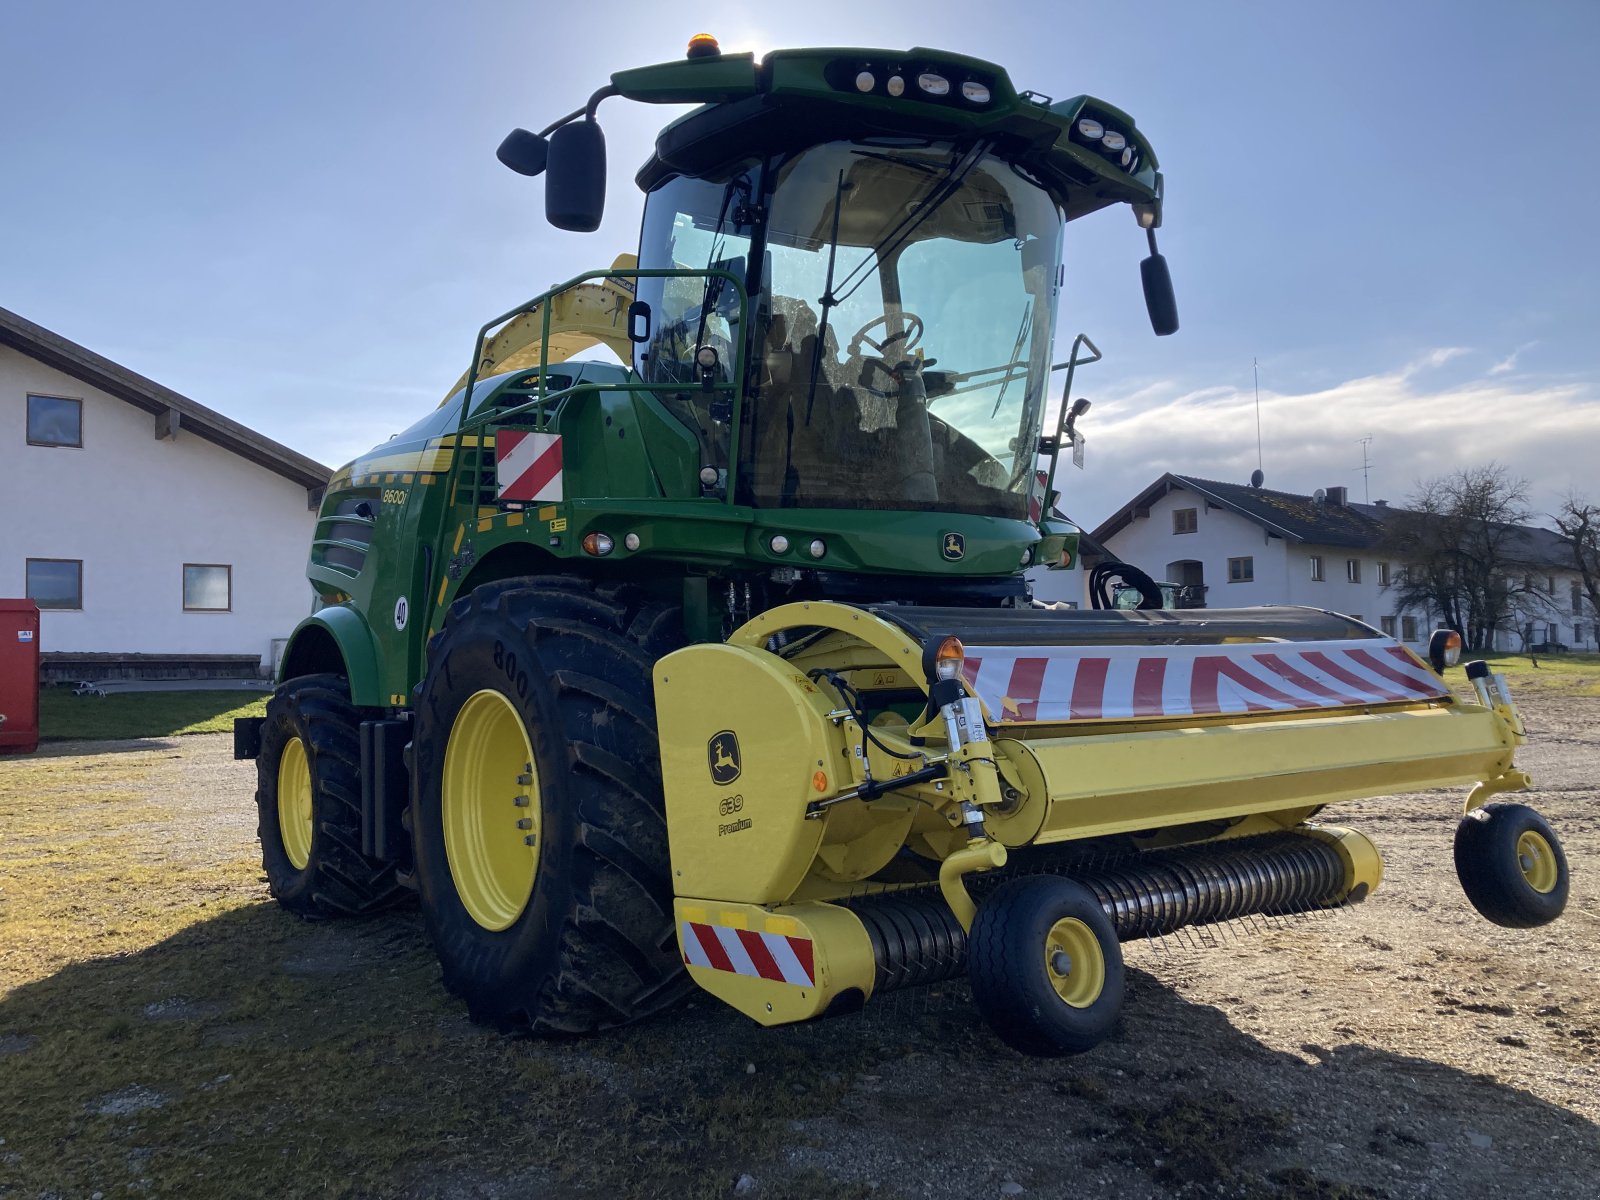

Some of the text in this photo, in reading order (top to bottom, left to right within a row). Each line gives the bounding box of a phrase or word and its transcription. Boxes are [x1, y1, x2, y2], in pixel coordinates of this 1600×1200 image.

[383, 489, 409, 505] 8600i
[396, 602, 406, 624] 40
[719, 794, 744, 816] 639
[718, 818, 753, 837] Premium
